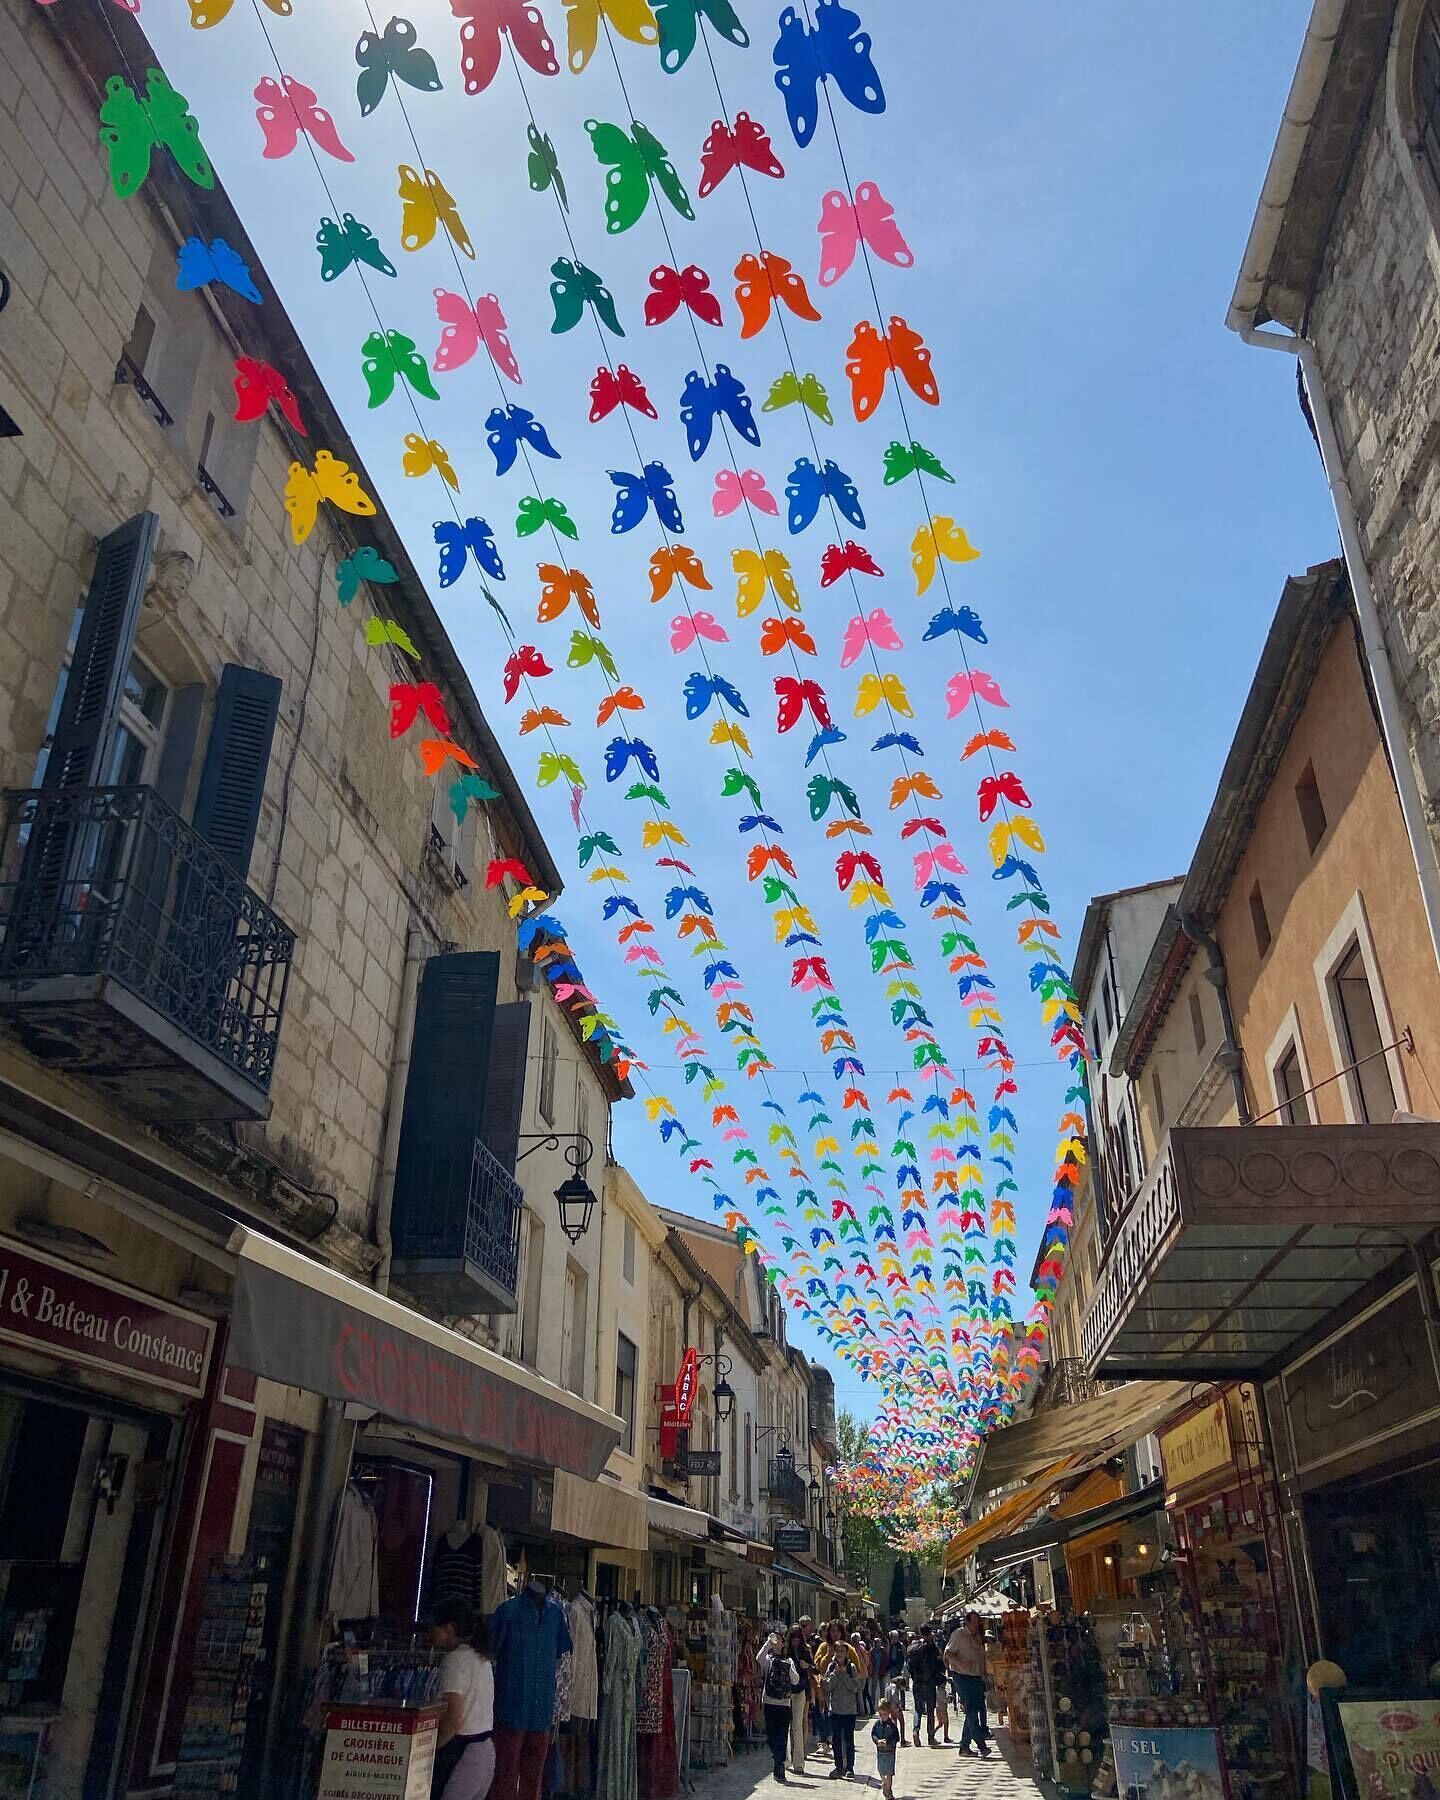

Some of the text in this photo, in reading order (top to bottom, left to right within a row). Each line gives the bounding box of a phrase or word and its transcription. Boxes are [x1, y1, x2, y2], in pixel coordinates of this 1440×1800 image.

[10, 1277, 34, 1317] &
[34, 1285, 110, 1343] Bateau
[113, 1315, 203, 1374] Constance
[679, 1363, 693, 1411] TABAC
[690, 1461, 705, 1469] FDJ
[340, 1719, 403, 1733] BILLETTERIE
[343, 1737, 395, 1751] CROISIÈRE
[1131, 1740, 1161, 1755] SEL
[330, 1751, 344, 1761] DE
[346, 1752, 404, 1766] CAMARGUE
[344, 1770, 402, 1781] AIGUES-MORTES
